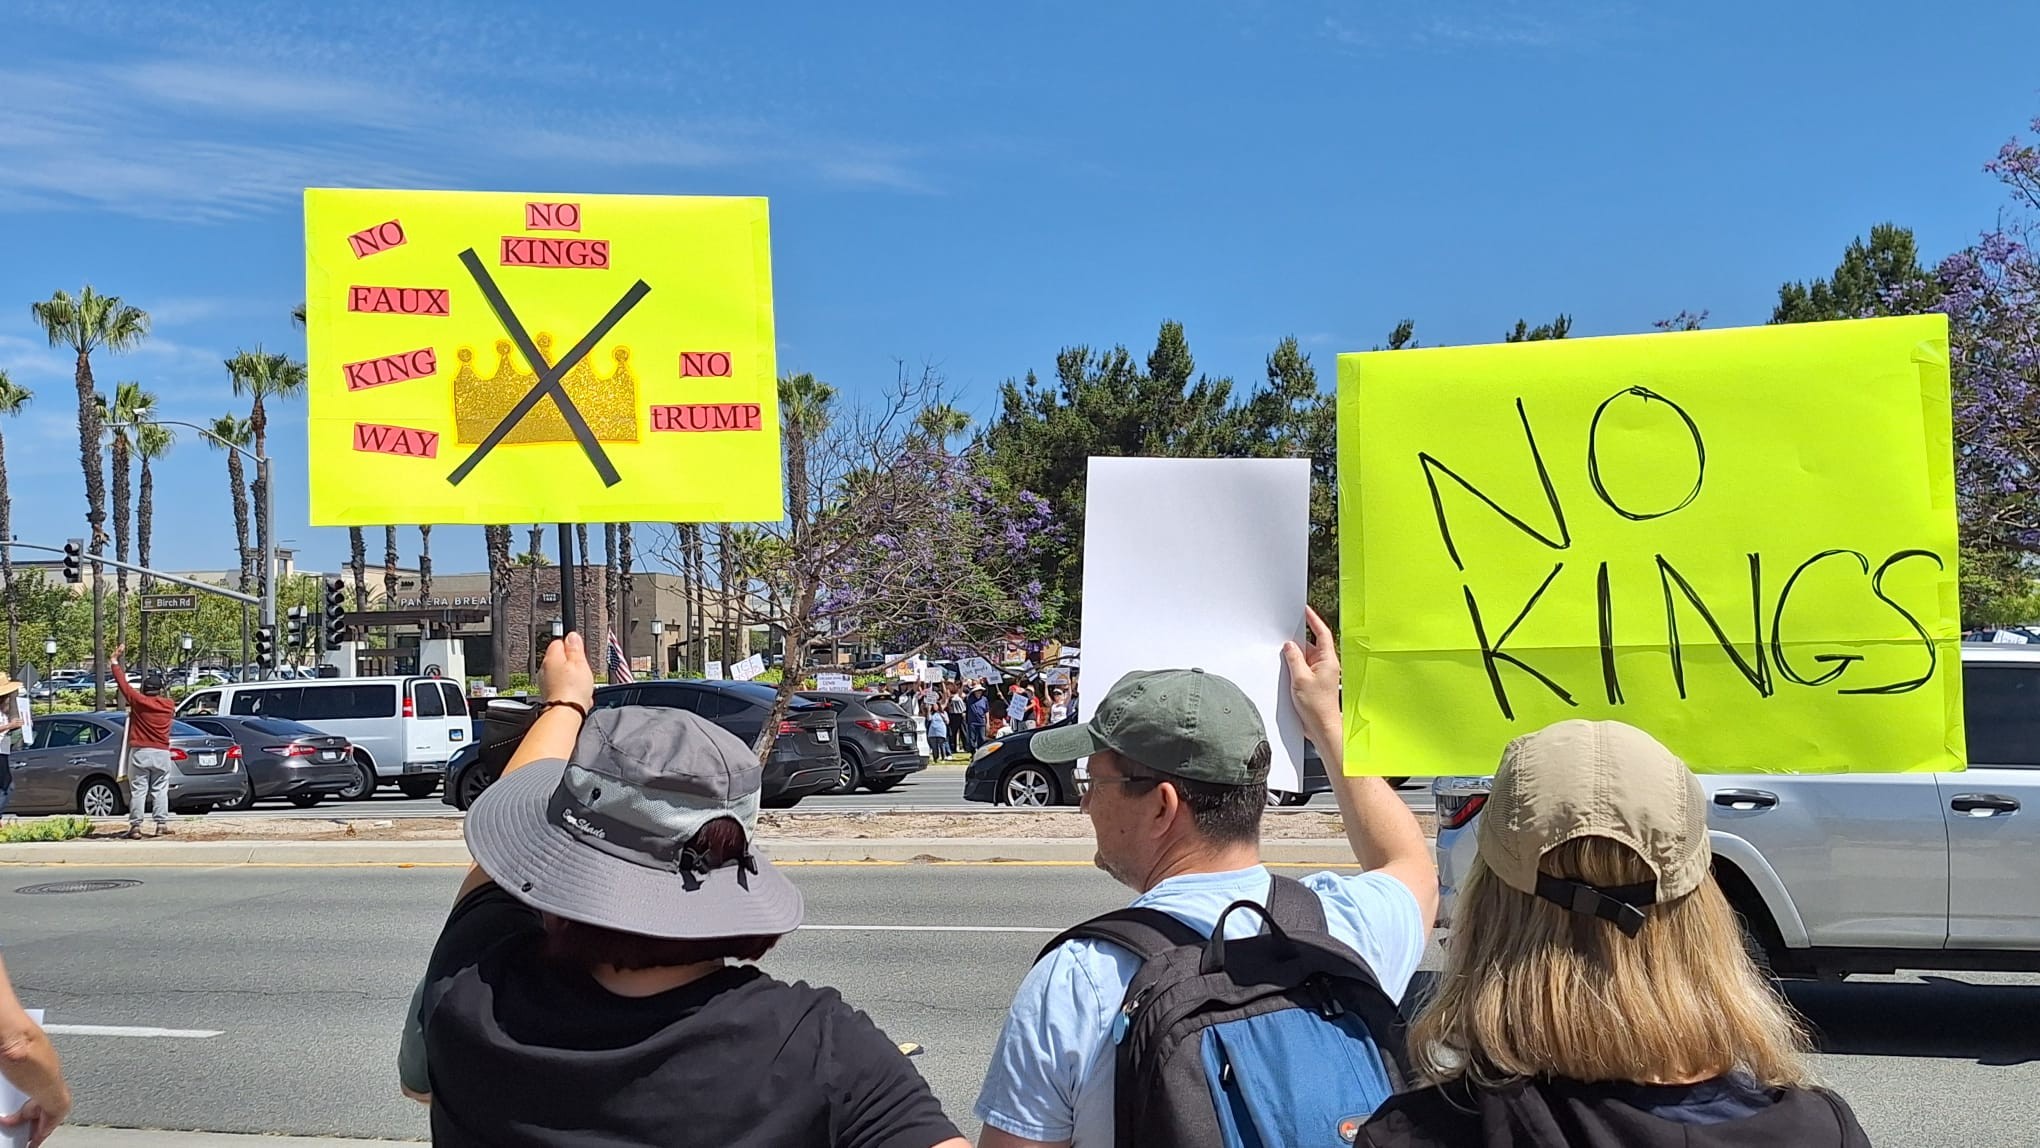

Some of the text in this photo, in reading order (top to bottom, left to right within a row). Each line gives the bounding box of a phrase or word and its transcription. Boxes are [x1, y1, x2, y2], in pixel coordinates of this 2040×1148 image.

[529, 204, 578, 227] NO
[352, 222, 404, 257] NO
[503, 239, 607, 266] KINGS
[351, 287, 448, 314] FAUX
[347, 350, 436, 388] KING
[681, 353, 730, 377] NO
[653, 405, 760, 430] tRUMP
[357, 426, 437, 457] WAY
[1419, 385, 1706, 571] NO
[156, 598, 191, 607] Birch Rd
[454, 595, 492, 605] BREA
[1463, 549, 1944, 721] KINGS
